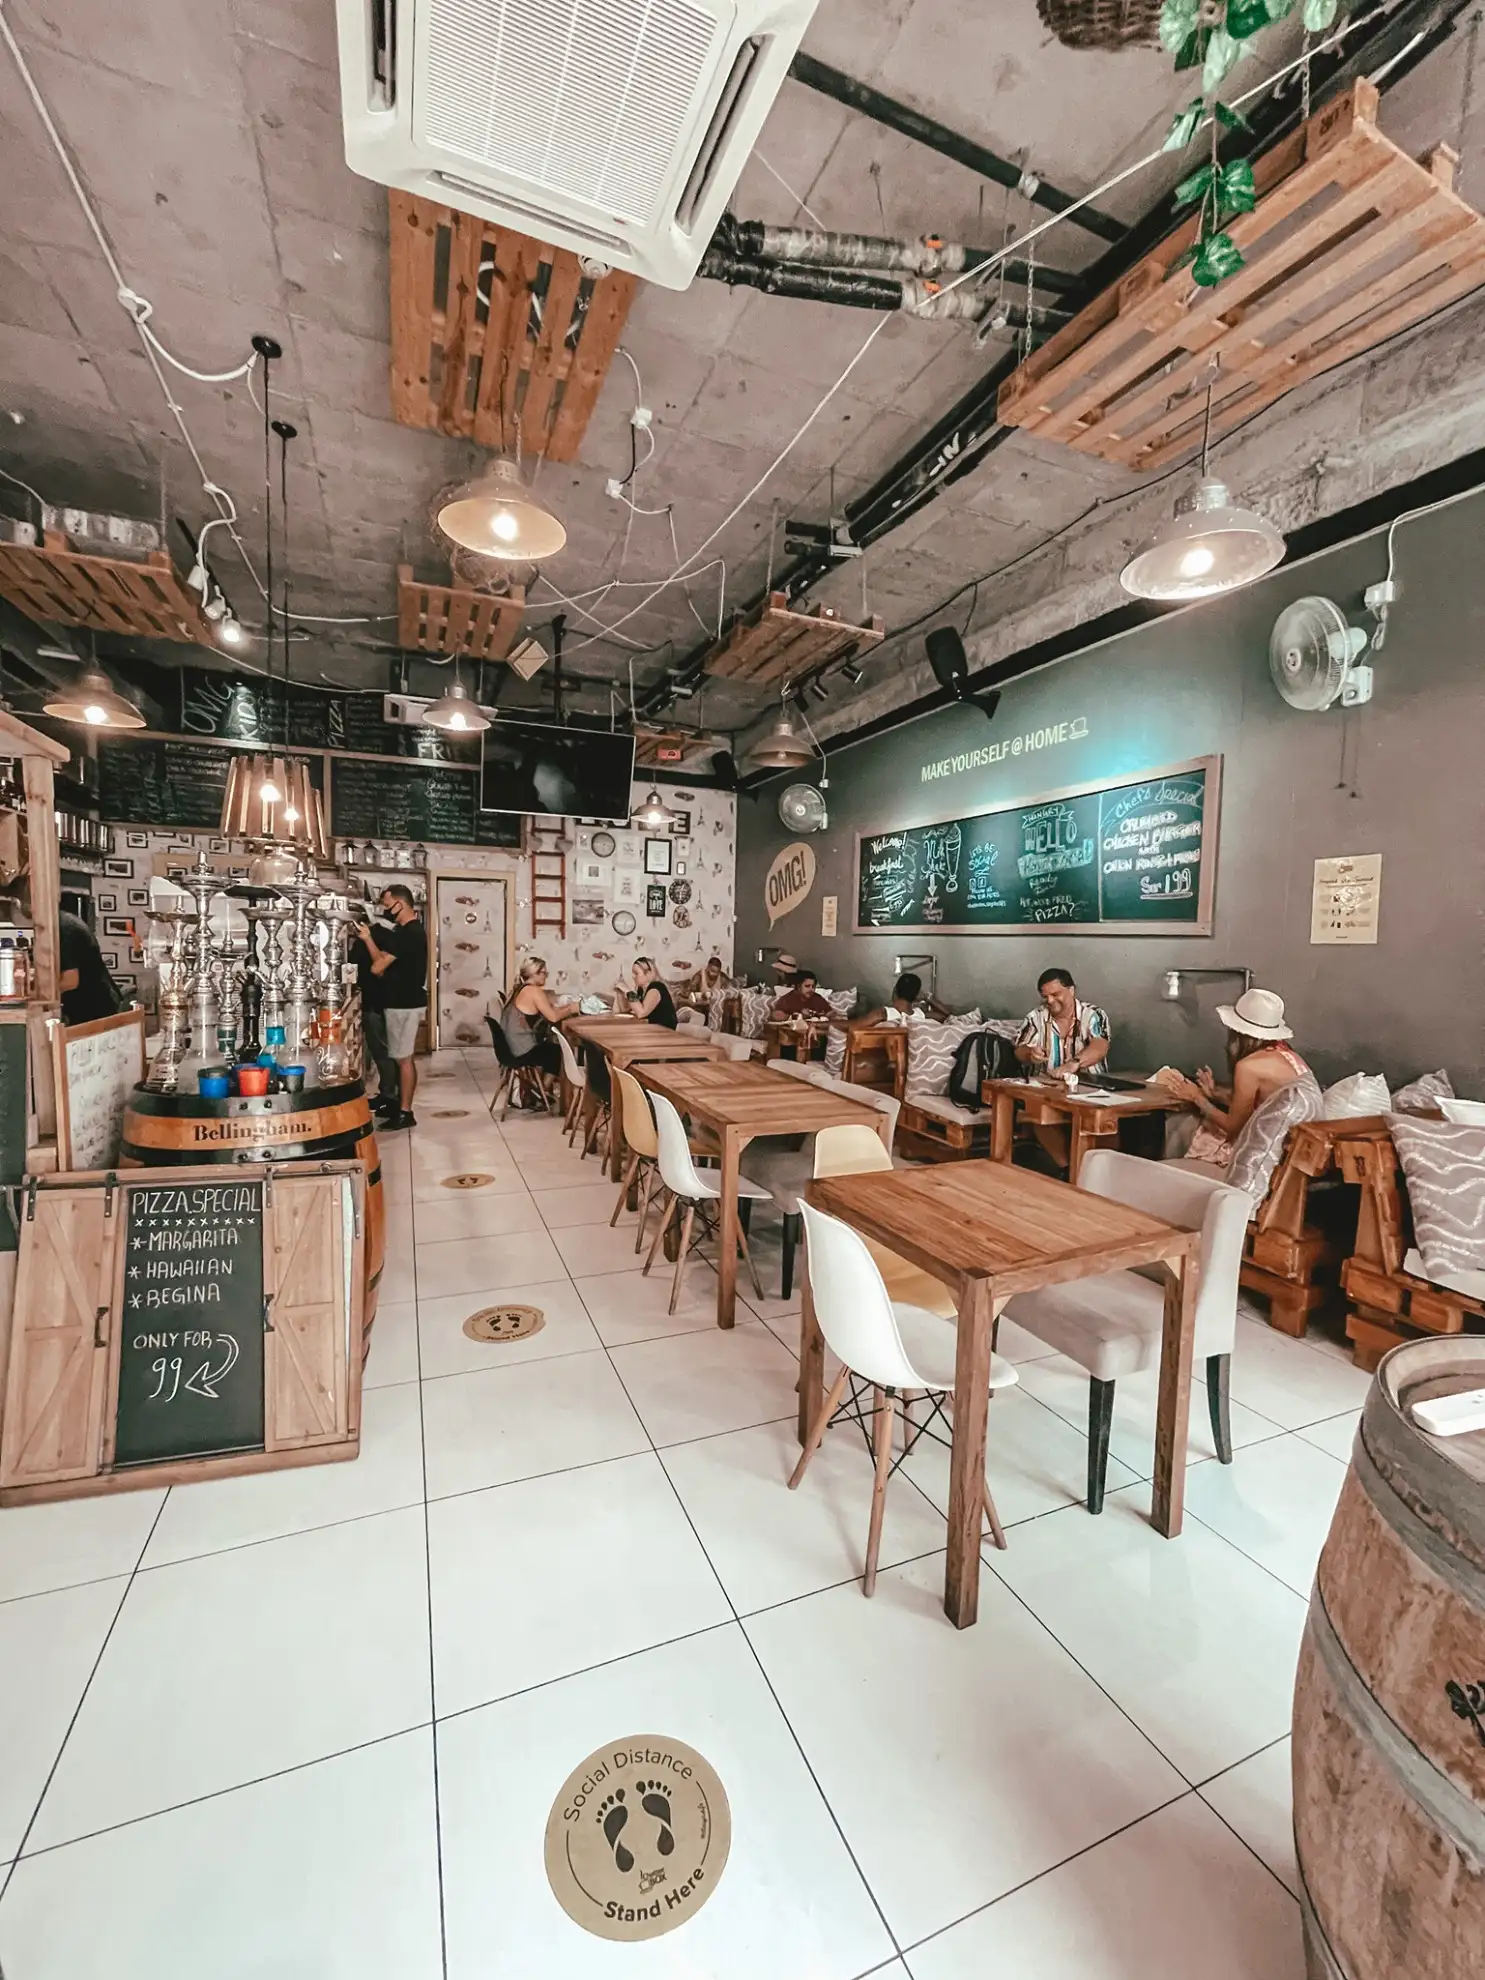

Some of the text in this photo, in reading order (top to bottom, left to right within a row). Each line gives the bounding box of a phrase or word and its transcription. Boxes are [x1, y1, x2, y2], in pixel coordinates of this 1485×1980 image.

[921, 722, 1069, 782] MAKE YOURSELF @ HOME
[769, 850, 807, 907] OMG!
[1035, 902, 1075, 922] PIZZA?
[148, 1227, 240, 1252] MARGARITA
[146, 1259, 234, 1279] HAWAIIAN
[146, 1284, 221, 1308] REGINA
[133, 1330, 213, 1350] ONLY FOR
[150, 1357, 183, 1403] 99
[564, 1748, 693, 1823] Social Distance
[603, 1867, 704, 1922] Stand Here
